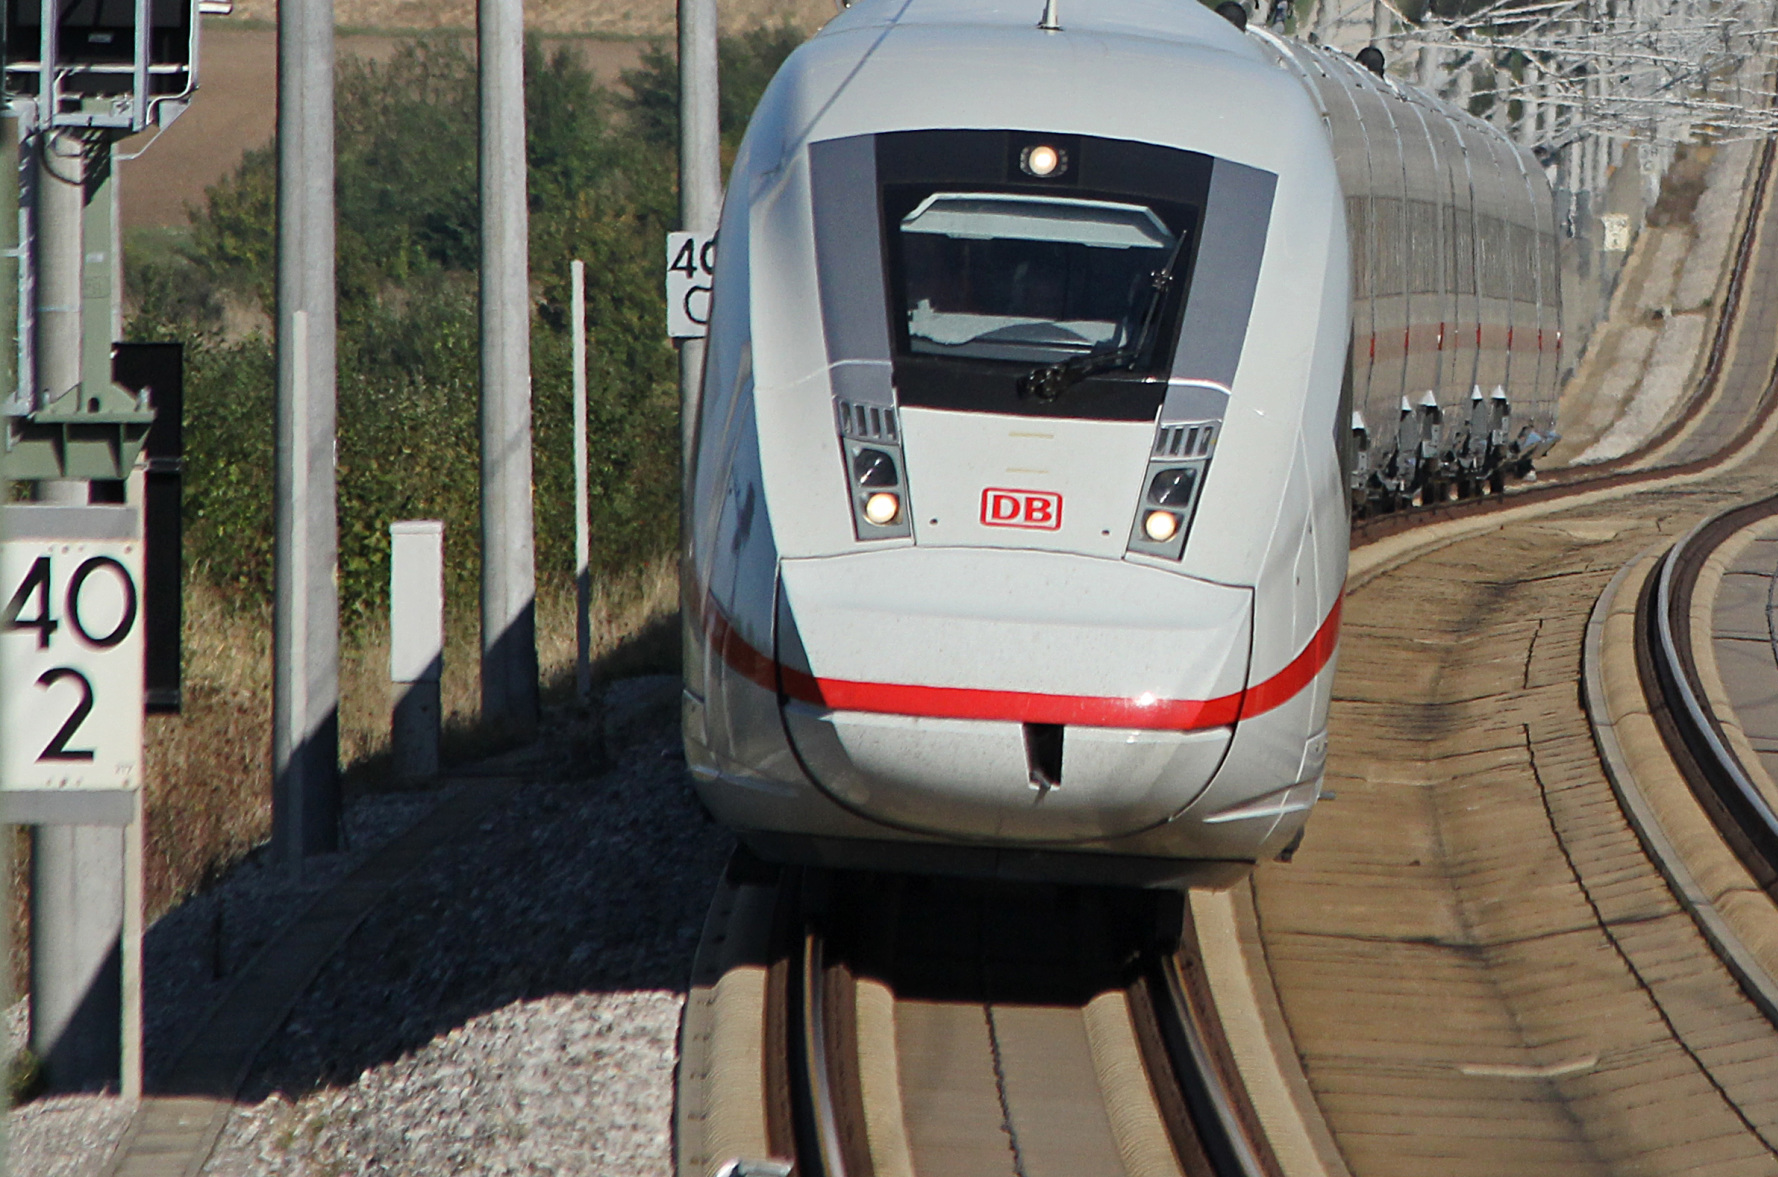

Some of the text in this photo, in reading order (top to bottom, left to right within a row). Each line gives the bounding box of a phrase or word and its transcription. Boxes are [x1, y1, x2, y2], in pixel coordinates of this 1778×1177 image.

[990, 495, 1053, 525] DB
[1, 555, 137, 652] 40
[33, 666, 95, 763] 2
